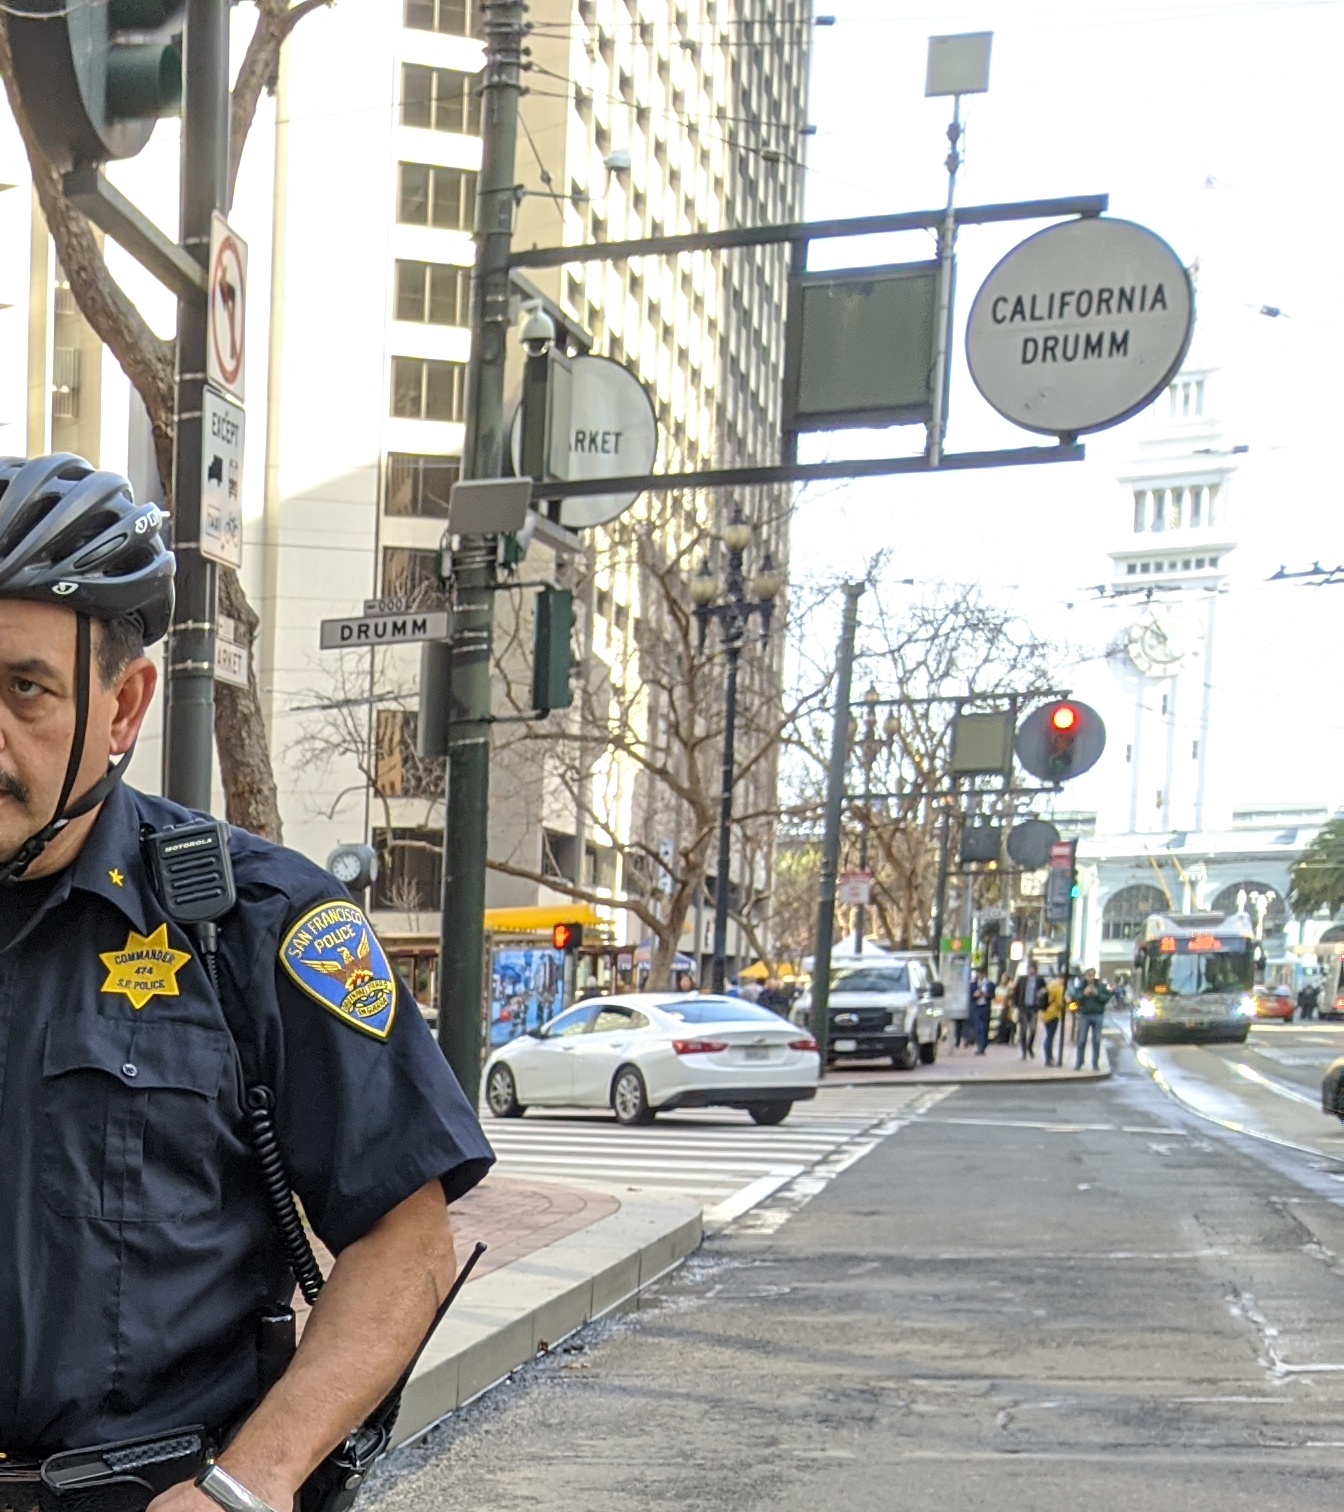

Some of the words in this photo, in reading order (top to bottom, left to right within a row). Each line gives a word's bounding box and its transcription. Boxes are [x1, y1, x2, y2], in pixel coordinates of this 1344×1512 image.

[992, 283, 1167, 324] CALIFORNIA
[1021, 329, 1129, 364] DRUMM
[212, 412, 239, 448] EXCEPT
[569, 430, 622, 455] RKET
[340, 618, 427, 641] DRUMM
[164, 838, 213, 853] MOTOROLA
[288, 930, 313, 958] SAN
[308, 908, 363, 934] FRANCISCO
[314, 923, 356, 953] POLICE
[114, 949, 175, 965] COMMANDER
[134, 980, 165, 990] POLICE
